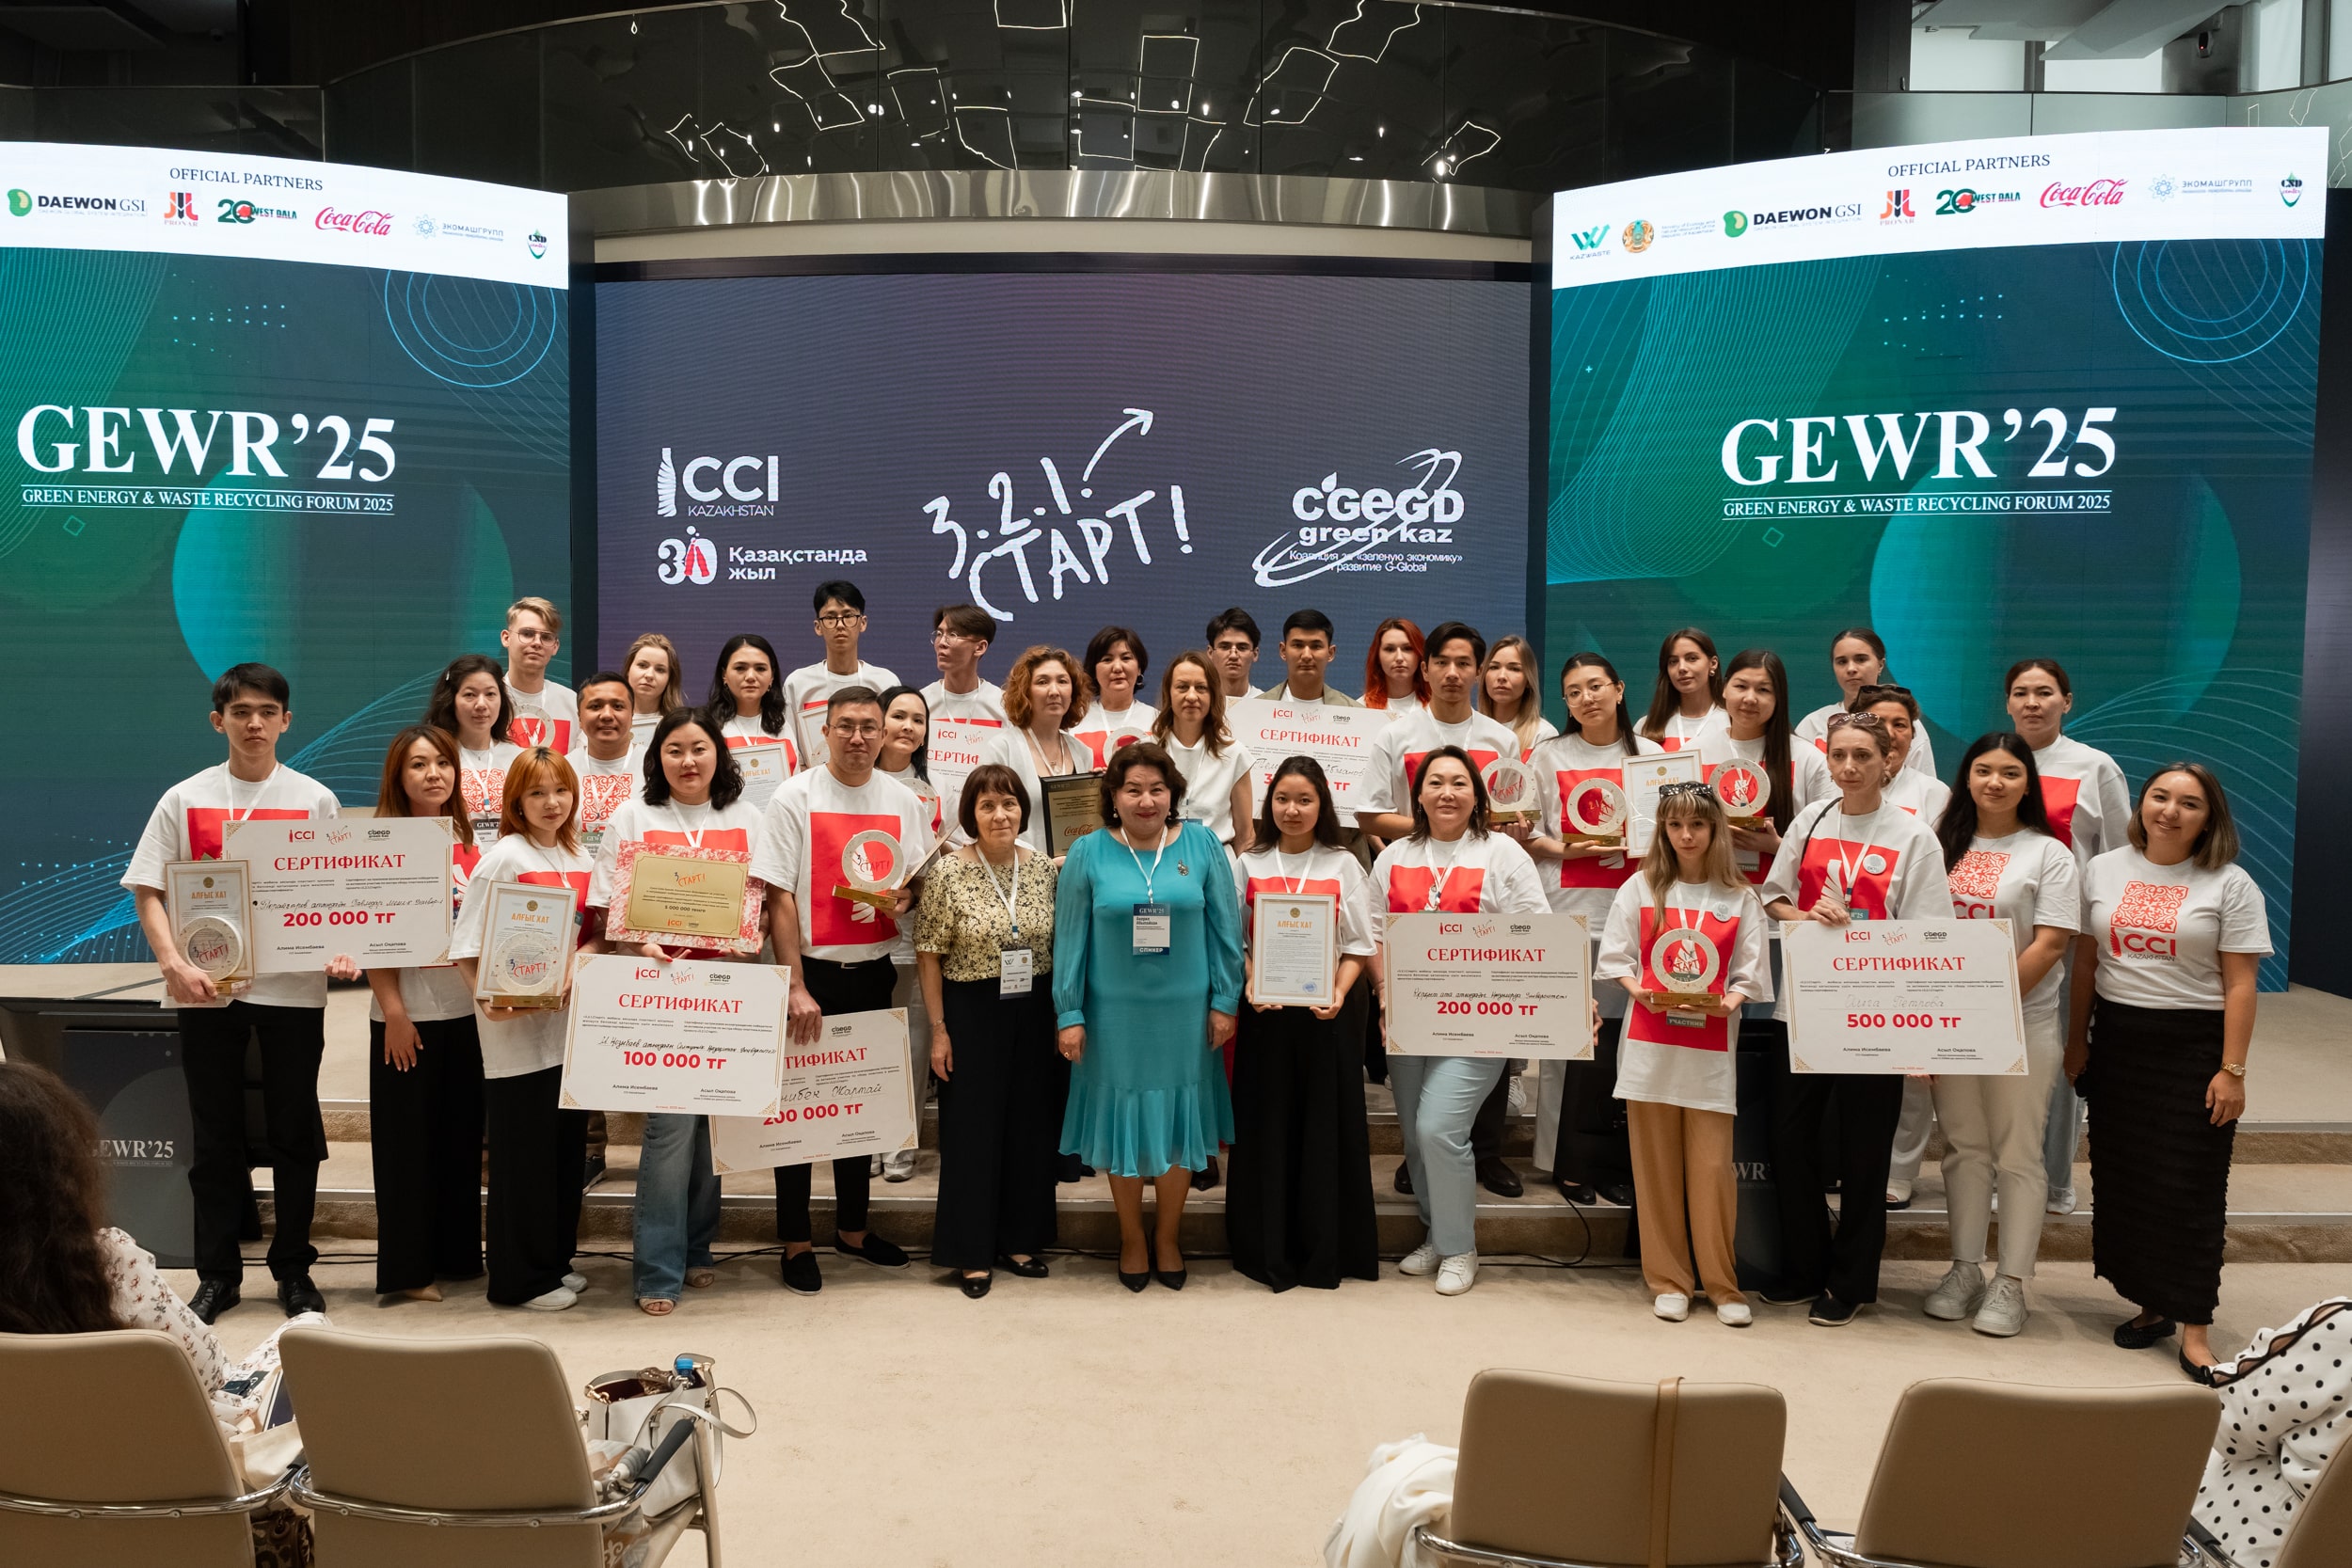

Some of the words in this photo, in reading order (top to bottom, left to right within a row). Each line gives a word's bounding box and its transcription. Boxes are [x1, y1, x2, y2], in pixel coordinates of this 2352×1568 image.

[1887, 160, 1961, 177] OFFICIAL
[1965, 154, 2051, 171] PARTNERS
[169, 167, 240, 183] OFFICIAL
[244, 172, 324, 191] PARTNERS
[2182, 179, 2252, 188] ЭКОМАШГРУПП
[1974, 193, 1996, 203] WEST
[1998, 192, 2021, 202] DALA
[2040, 179, 2129, 208] Coca-Cola
[38, 196, 117, 210] DAEWON
[119, 198, 146, 213] GSI
[252, 207, 274, 218] WEST
[277, 210, 297, 219] DALA
[1754, 206, 1832, 226] DAEWON
[1835, 203, 1862, 218] GSI
[315, 207, 395, 236] Coca-Cola
[442, 223, 504, 236] ЭКОМАШГРУПП
[1569, 250, 1612, 260] KAZWASTE
[17, 404, 396, 483] GEWR’25
[1721, 406, 2117, 486] GEWR’25
[22, 488, 73, 503] GREEN
[78, 489, 138, 505] ENERGY
[142, 491, 155, 505] &
[159, 492, 211, 506] WASTE
[215, 493, 303, 509] RECYCLING
[307, 496, 359, 511] FORUM
[363, 498, 394, 512] 2025
[1724, 500, 1774, 516] GREEN
[1778, 499, 1841, 515] ENERGY
[1844, 499, 1856, 513] &
[1860, 498, 1914, 513] WASTE
[1916, 496, 2011, 512] RECYCLING
[2014, 495, 2074, 510] FORUM
[2077, 494, 2110, 509] 2025
[688, 504, 774, 516] KAZAKHSTAN
[1299, 527, 1389, 546] green
[1399, 527, 1454, 543] kaz
[729, 546, 867, 565] Қазақстанда
[1406, 553, 1463, 564] экономику»
[728, 567, 776, 580] жыл
[1337, 562, 1382, 573] развитие
[1385, 562, 1427, 573] G-Global
[1260, 728, 1361, 748] СЕРТИФИКАТ
[927, 749, 979, 765] СЕРТИФ
[274, 854, 406, 871] СЕРТИФИКАТ
[282, 912, 322, 927] 200
[329, 911, 369, 926] 000
[374, 911, 396, 924] тг
[536, 915, 550, 925] ХАТ
[1300, 921, 1313, 929] ХАТ
[1426, 948, 1546, 961] СЕРТИФИКАТ
[2127, 953, 2175, 961] KAZAKHSTAN
[514, 962, 547, 977] СТАРТ!
[1833, 957, 1965, 971] СЕРТИФИКАТ
[618, 993, 743, 1013] СЕРТИФИКАТ
[1437, 1001, 1470, 1014] 200
[1477, 1002, 1513, 1016] 000
[1518, 1006, 1538, 1016] тг
[1669, 1018, 1704, 1027] УЧАСТНИК
[1847, 1014, 1886, 1028] 500
[1892, 1014, 1933, 1028] 000
[1939, 1017, 1962, 1028] тг
[624, 1051, 657, 1066] 100
[662, 1053, 701, 1069] 000
[706, 1057, 726, 1069] тг
[785, 1046, 867, 1069] ТИФИКАТ
[803, 1103, 839, 1120] 000
[844, 1103, 864, 1116] тг
[92, 1139, 174, 1159] EWR’25
